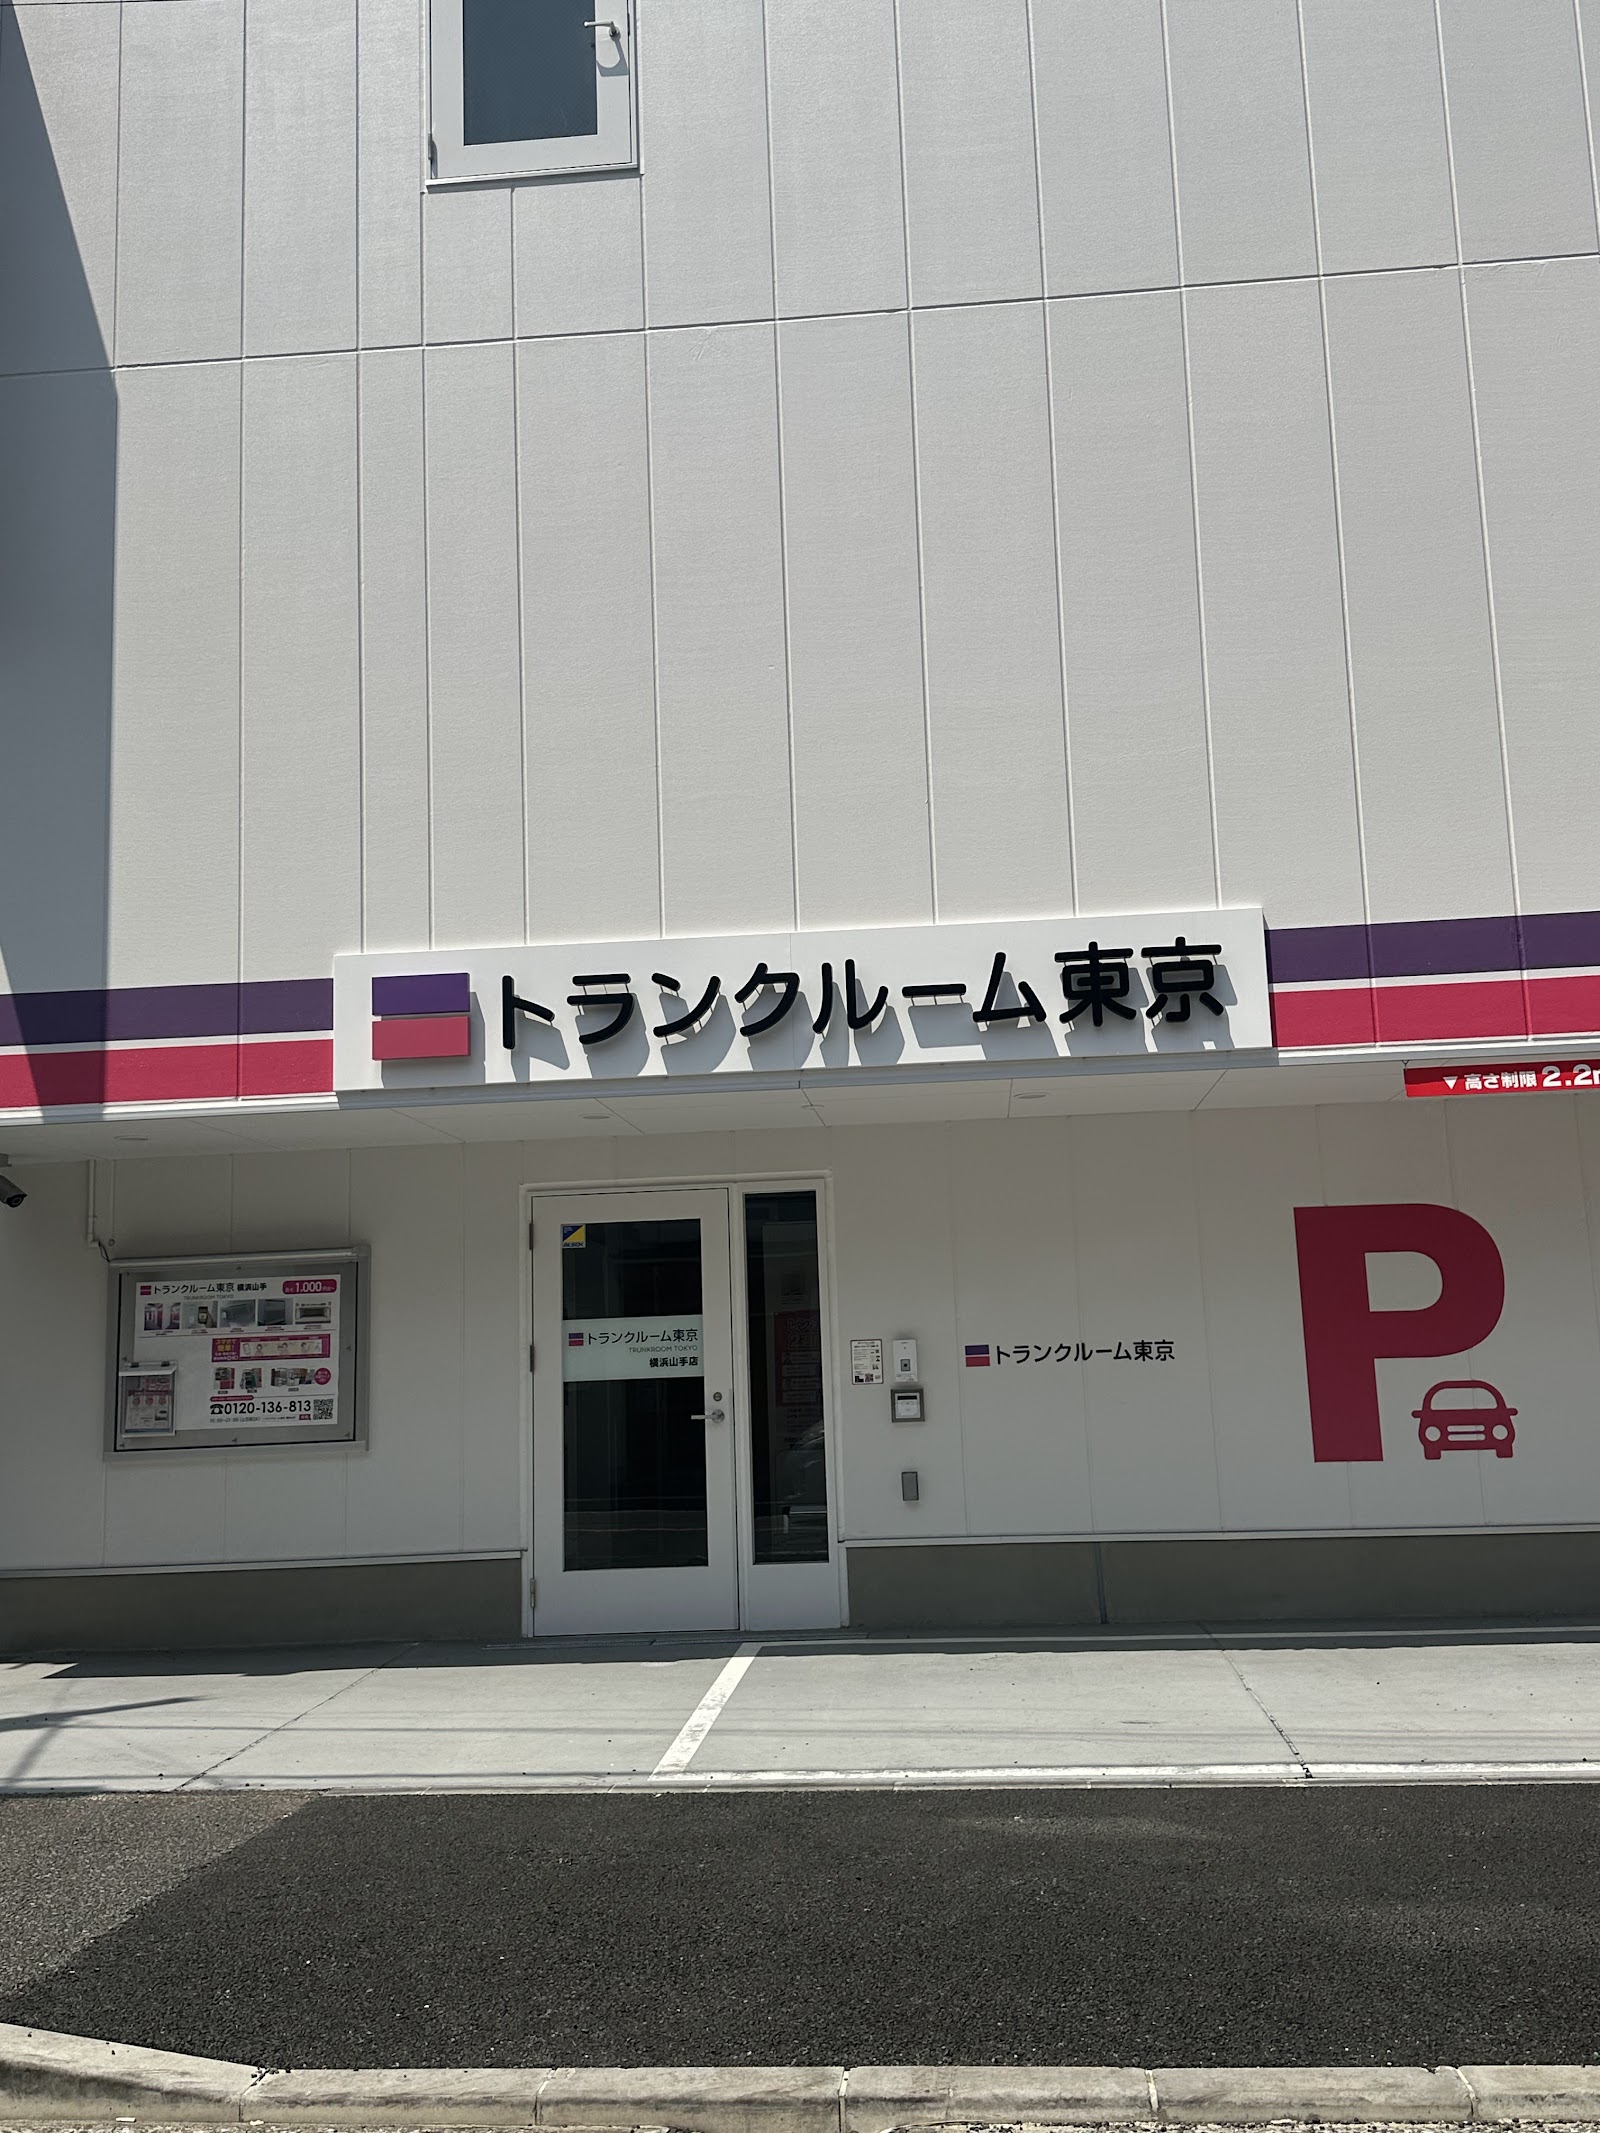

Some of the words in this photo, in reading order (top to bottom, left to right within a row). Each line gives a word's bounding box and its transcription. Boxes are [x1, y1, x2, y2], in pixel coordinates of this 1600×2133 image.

[501, 936, 1225, 1050] トランクルーム東京
[1463, 1070, 1538, 1091] 高さ制限
[153, 1282, 235, 1295] トランクルーム東京
[588, 1328, 699, 1346] トランクルーム東京
[1293, 1203, 1505, 1463] P
[996, 1339, 1176, 1365] トランクルーム東京
[649, 1356, 699, 1368] 横浜山手店
[224, 1400, 312, 1415] 0120-136-813
